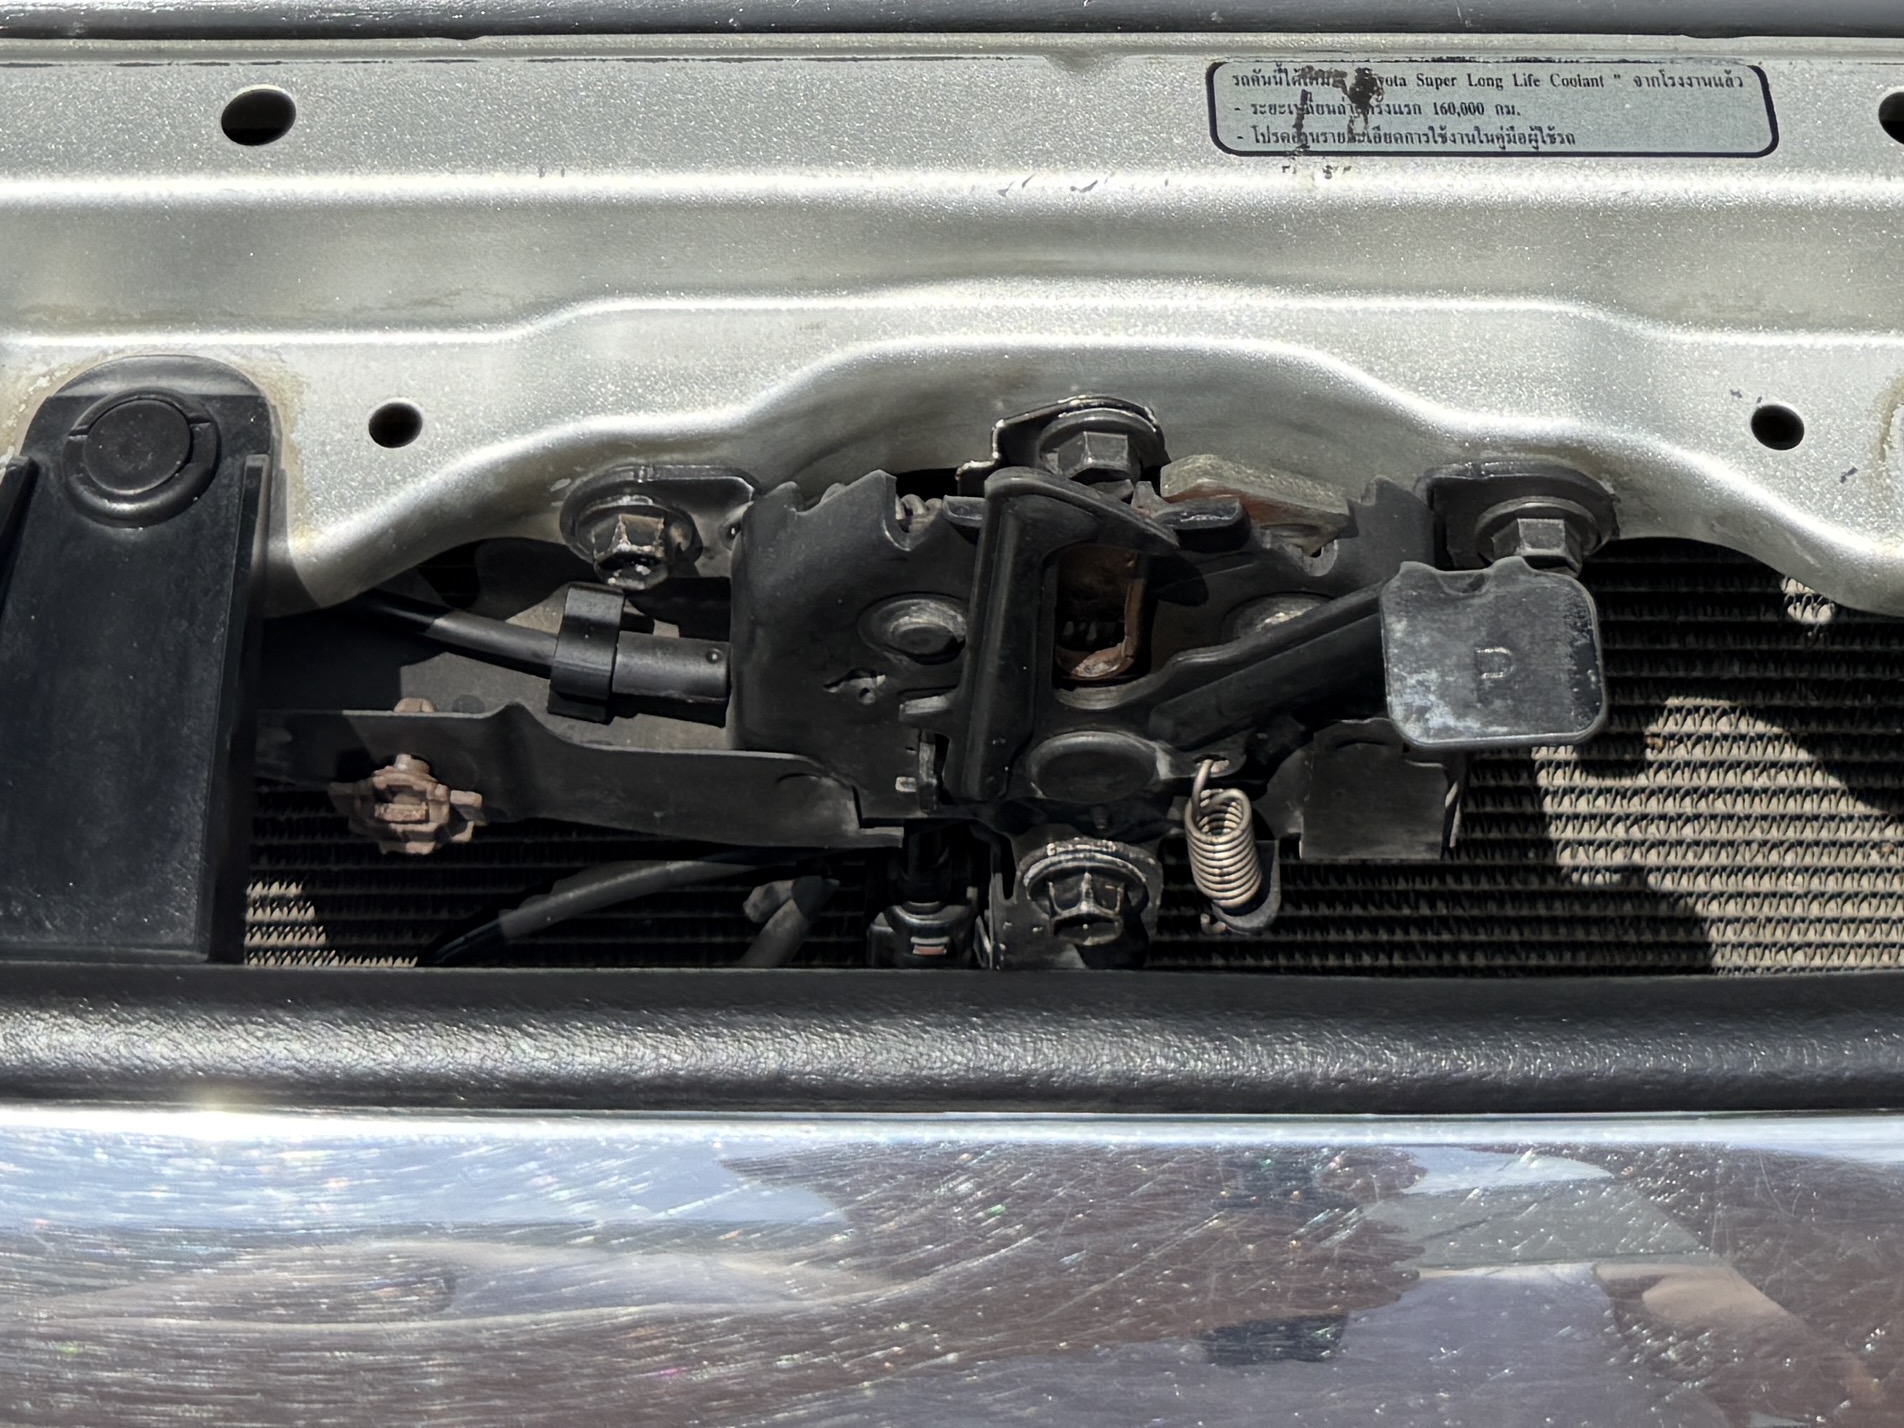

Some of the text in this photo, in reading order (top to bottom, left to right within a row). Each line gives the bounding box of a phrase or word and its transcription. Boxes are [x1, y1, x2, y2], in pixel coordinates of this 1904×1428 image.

[1415, 72, 1457, 94] Super
[1467, 72, 1504, 96] Long
[1513, 72, 1541, 89] Life
[1549, 72, 1605, 89] Coolant
[1432, 101, 1485, 118] 160,000
